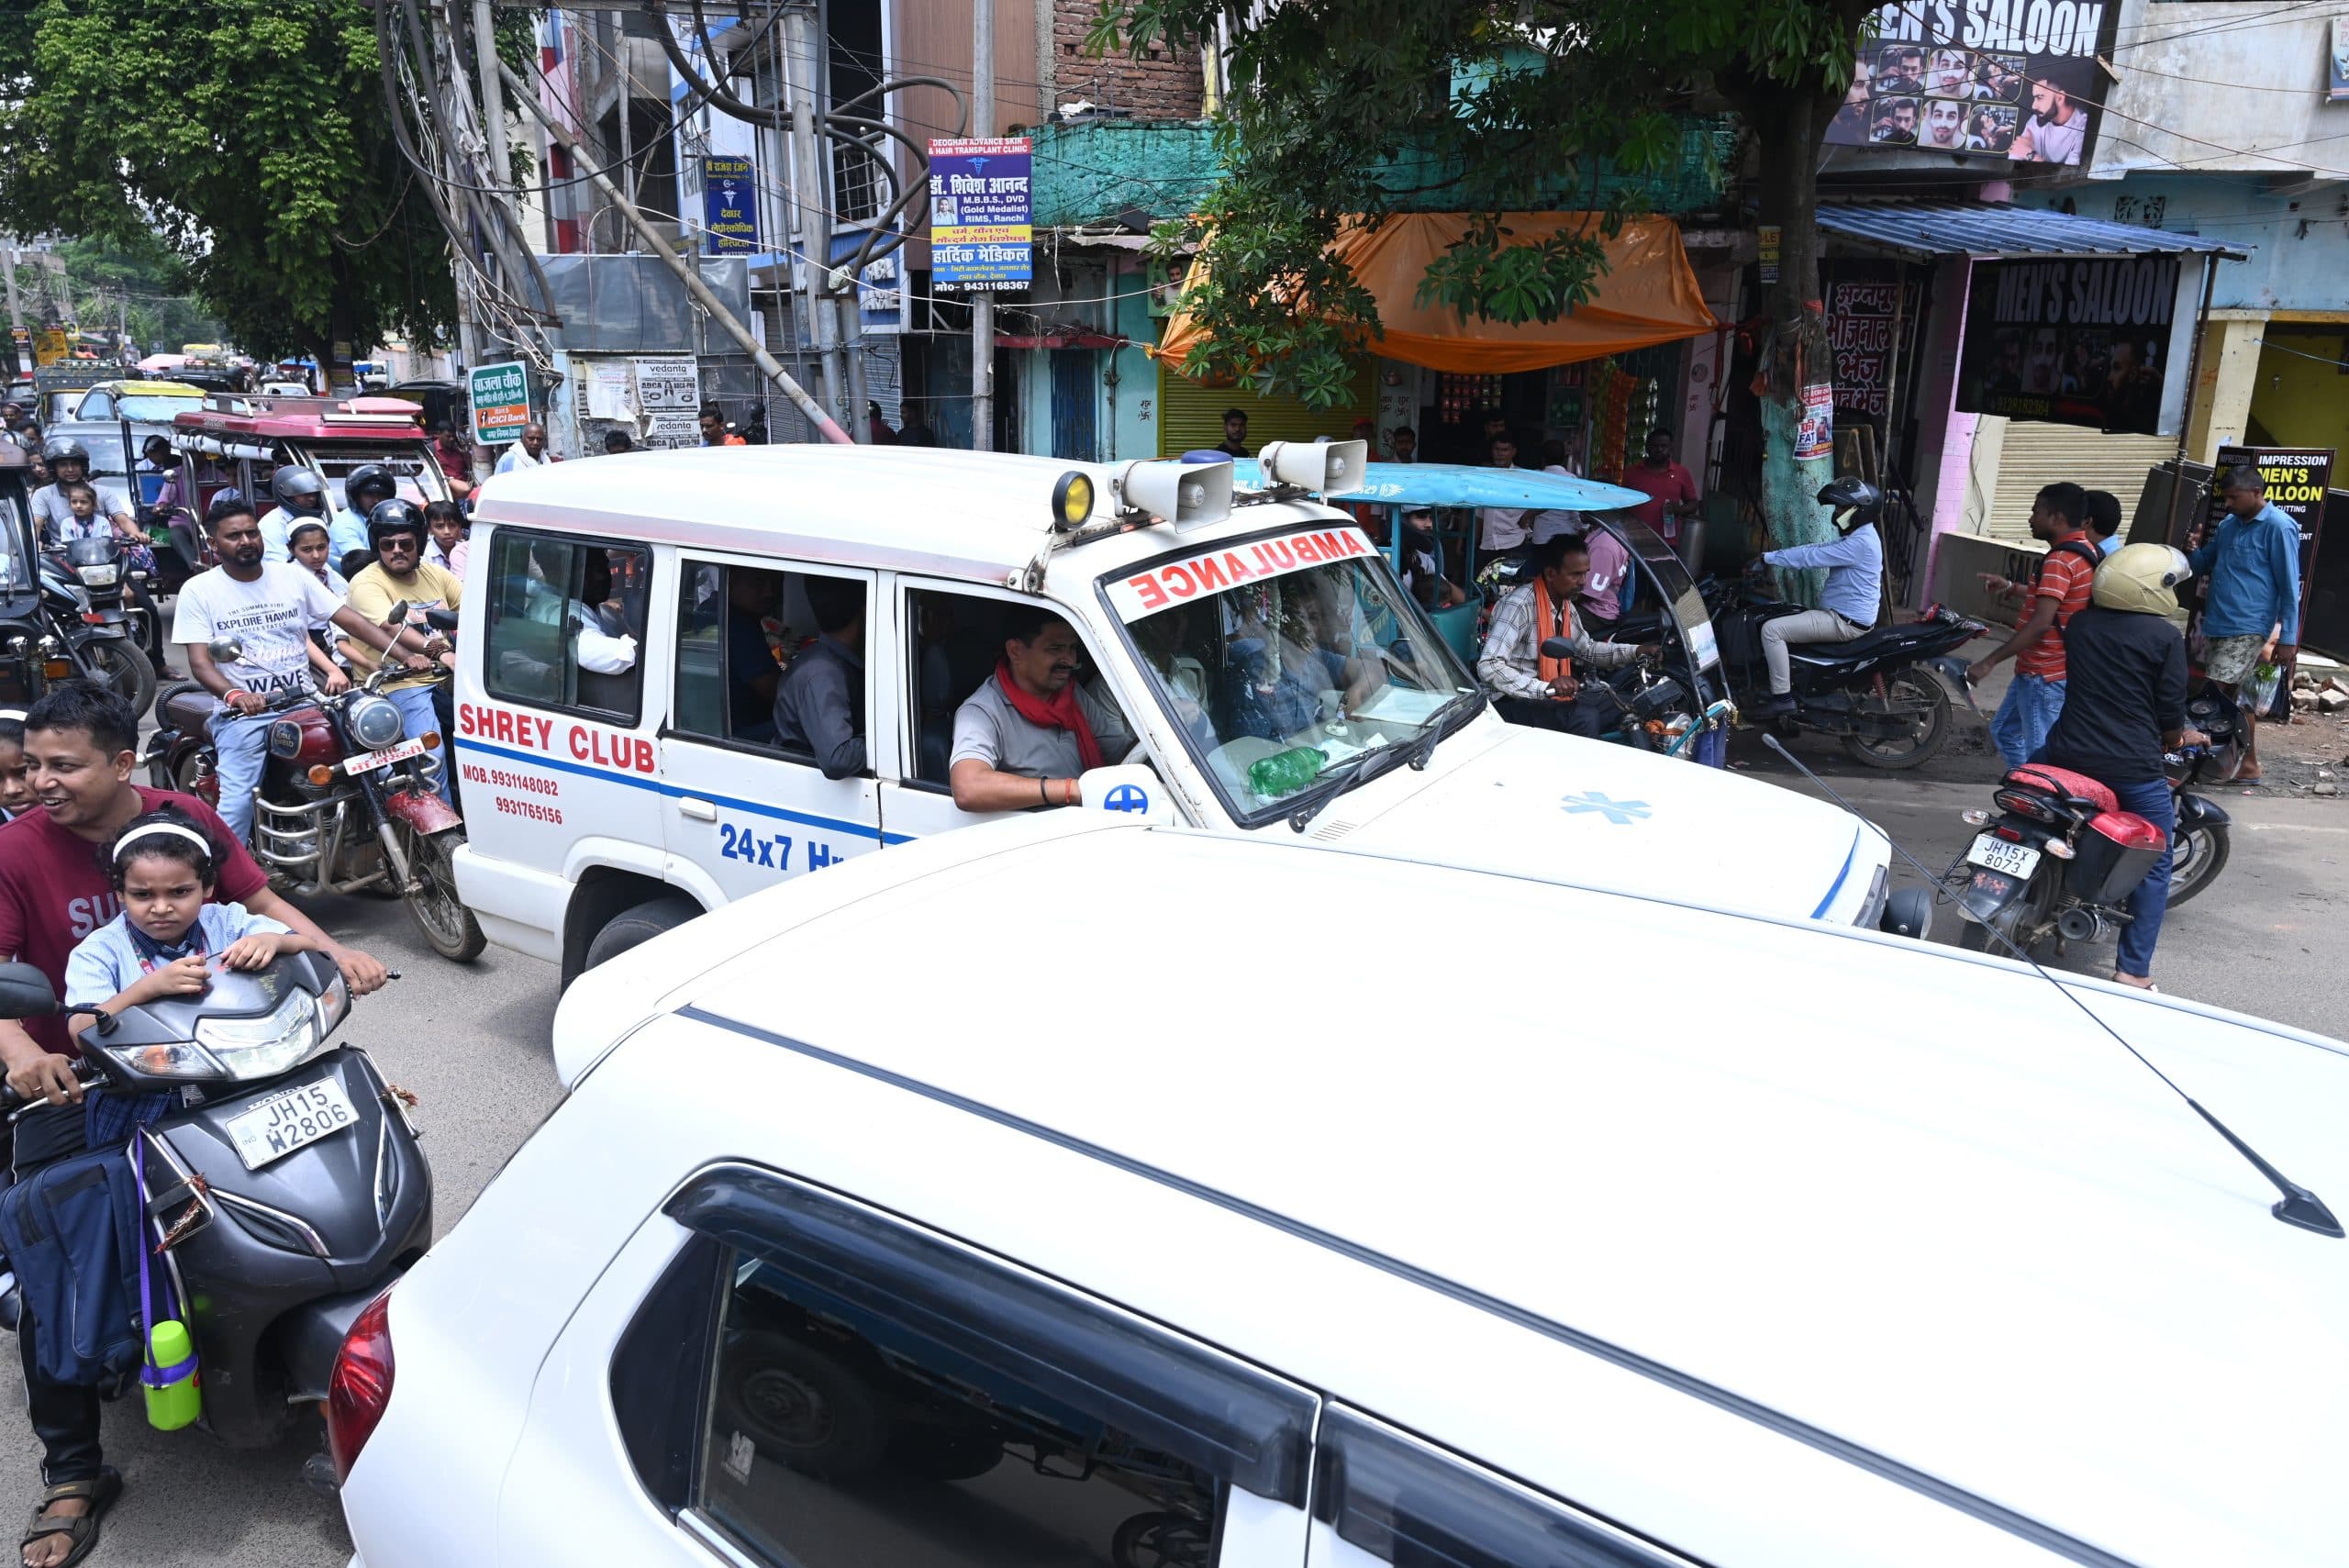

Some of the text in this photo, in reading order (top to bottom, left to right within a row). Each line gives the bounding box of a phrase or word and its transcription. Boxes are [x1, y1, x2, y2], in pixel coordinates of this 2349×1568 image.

[1962, 0, 2103, 58] SALOON
[928, 145, 1029, 155] & HAIR TRANSPLANT CLINIC
[932, 137, 1023, 147] DEOGHAR ADVANCE SKIN
[950, 173, 986, 195] शिवेश
[988, 176, 1029, 194] आनन्द
[961, 204, 1029, 214] (Gold Medalist)
[963, 195, 1025, 205] M.B.B.S., DVD
[965, 213, 1025, 223] RIMS, Ranchi
[932, 244, 1030, 263] हार्दिक मेडिकल
[963, 281, 1030, 291] 9431168367
[1995, 259, 2177, 326] MEN'S SALOON
[650, 364, 687, 373] vedanta
[473, 369, 522, 392] बाजला चौक
[487, 412, 527, 425] ICICI Bank
[1798, 432, 1816, 443] FAT
[2258, 455, 2328, 466] IMPRESSION
[2257, 467, 2309, 484] MEN'S
[2263, 485, 2323, 501] ALOON
[241, 603, 269, 612] SUMMER
[216, 616, 262, 630] EXPLORE
[264, 607, 299, 623] HAWAII
[235, 621, 287, 634] UNITED STATES
[245, 670, 305, 694] WAVE
[460, 703, 655, 773] SHREY CLUB
[495, 796, 562, 825] 9931765156
[720, 823, 793, 871] 24x7
[1984, 840, 2030, 862] JH15X
[1984, 853, 2021, 873] 8073
[269, 1086, 328, 1127] JH15
[265, 1104, 348, 1153] W2806
